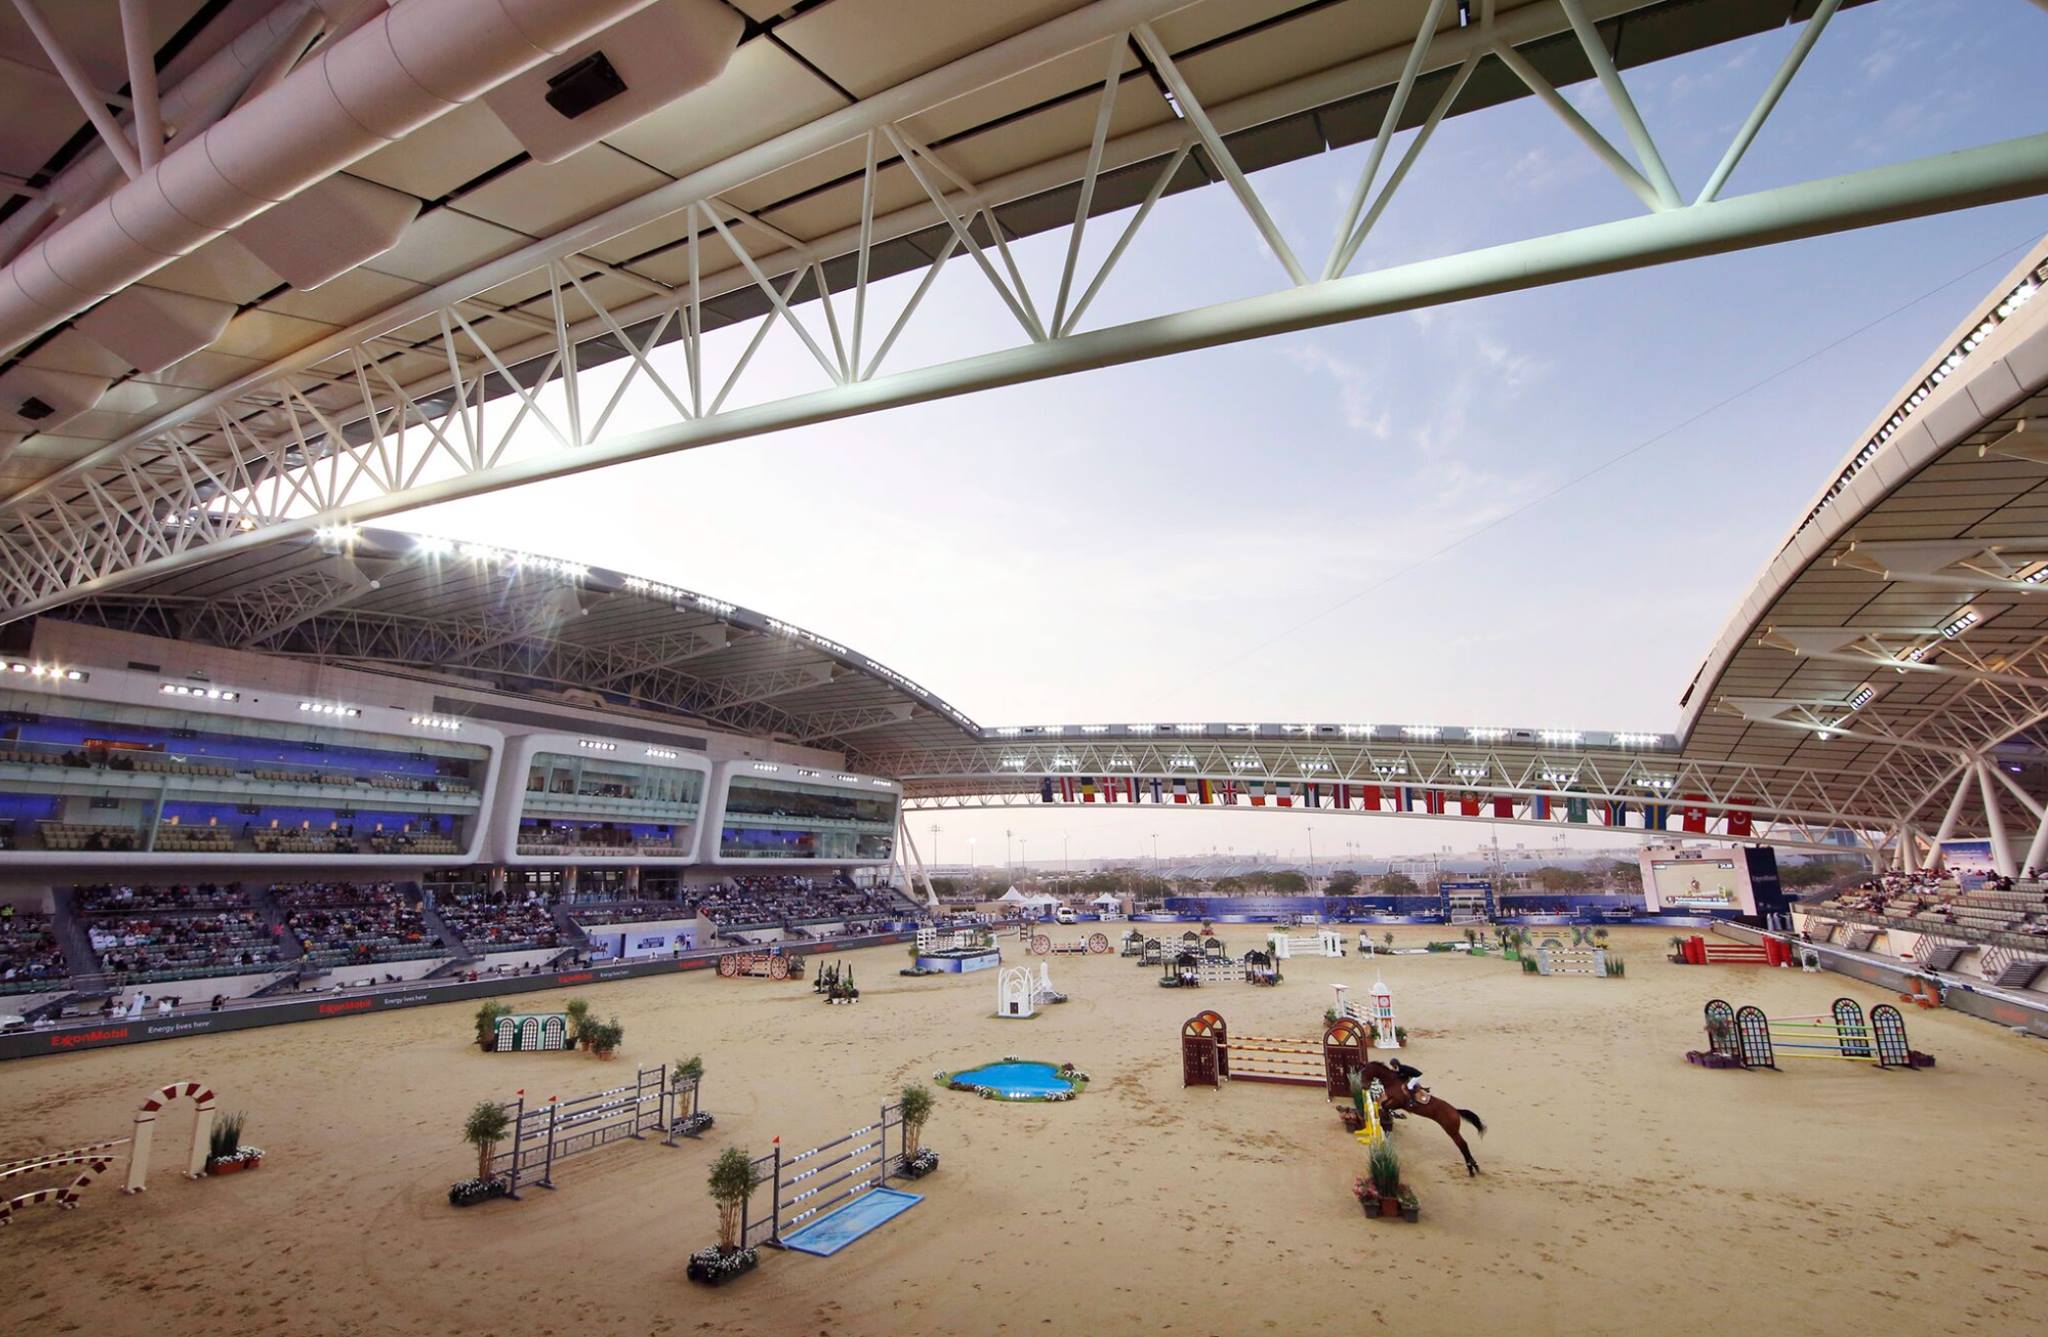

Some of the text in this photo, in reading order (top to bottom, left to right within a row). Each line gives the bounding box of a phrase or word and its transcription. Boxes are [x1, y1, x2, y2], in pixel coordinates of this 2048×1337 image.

[148, 1025, 174, 1034] Energy
[175, 1023, 192, 1031] lives
[51, 1029, 128, 1047] ExxonMobil
